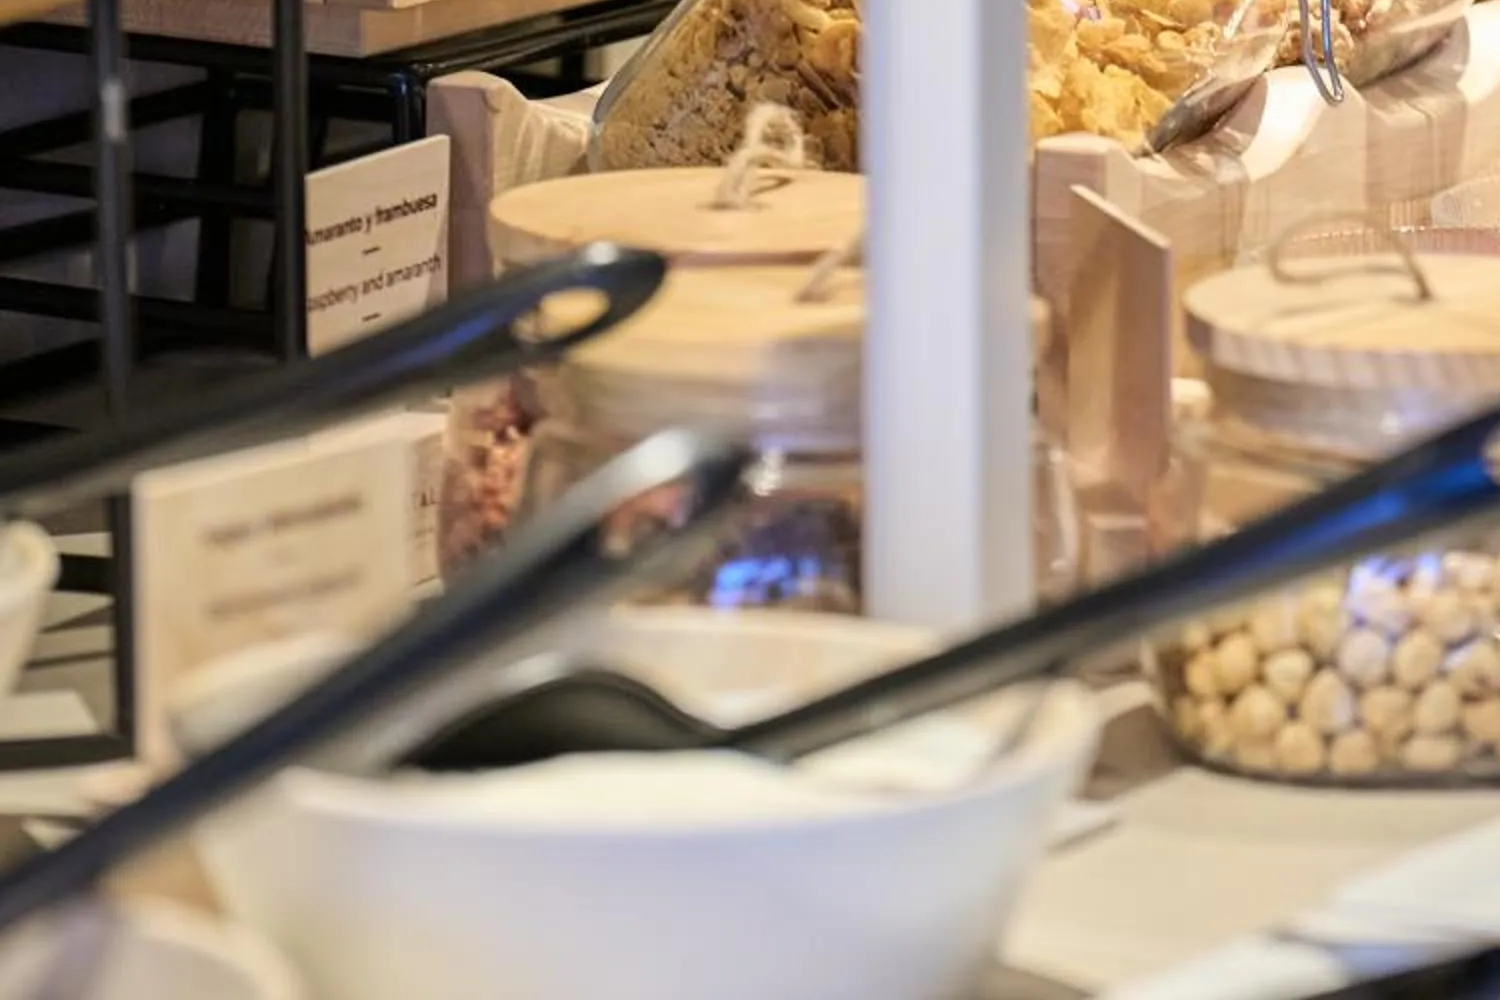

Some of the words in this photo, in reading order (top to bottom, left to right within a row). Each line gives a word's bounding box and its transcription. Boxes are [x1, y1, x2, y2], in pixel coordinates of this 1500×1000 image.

[363, 212, 373, 235] y
[308, 282, 358, 312] aspberry
[362, 271, 384, 296] and
